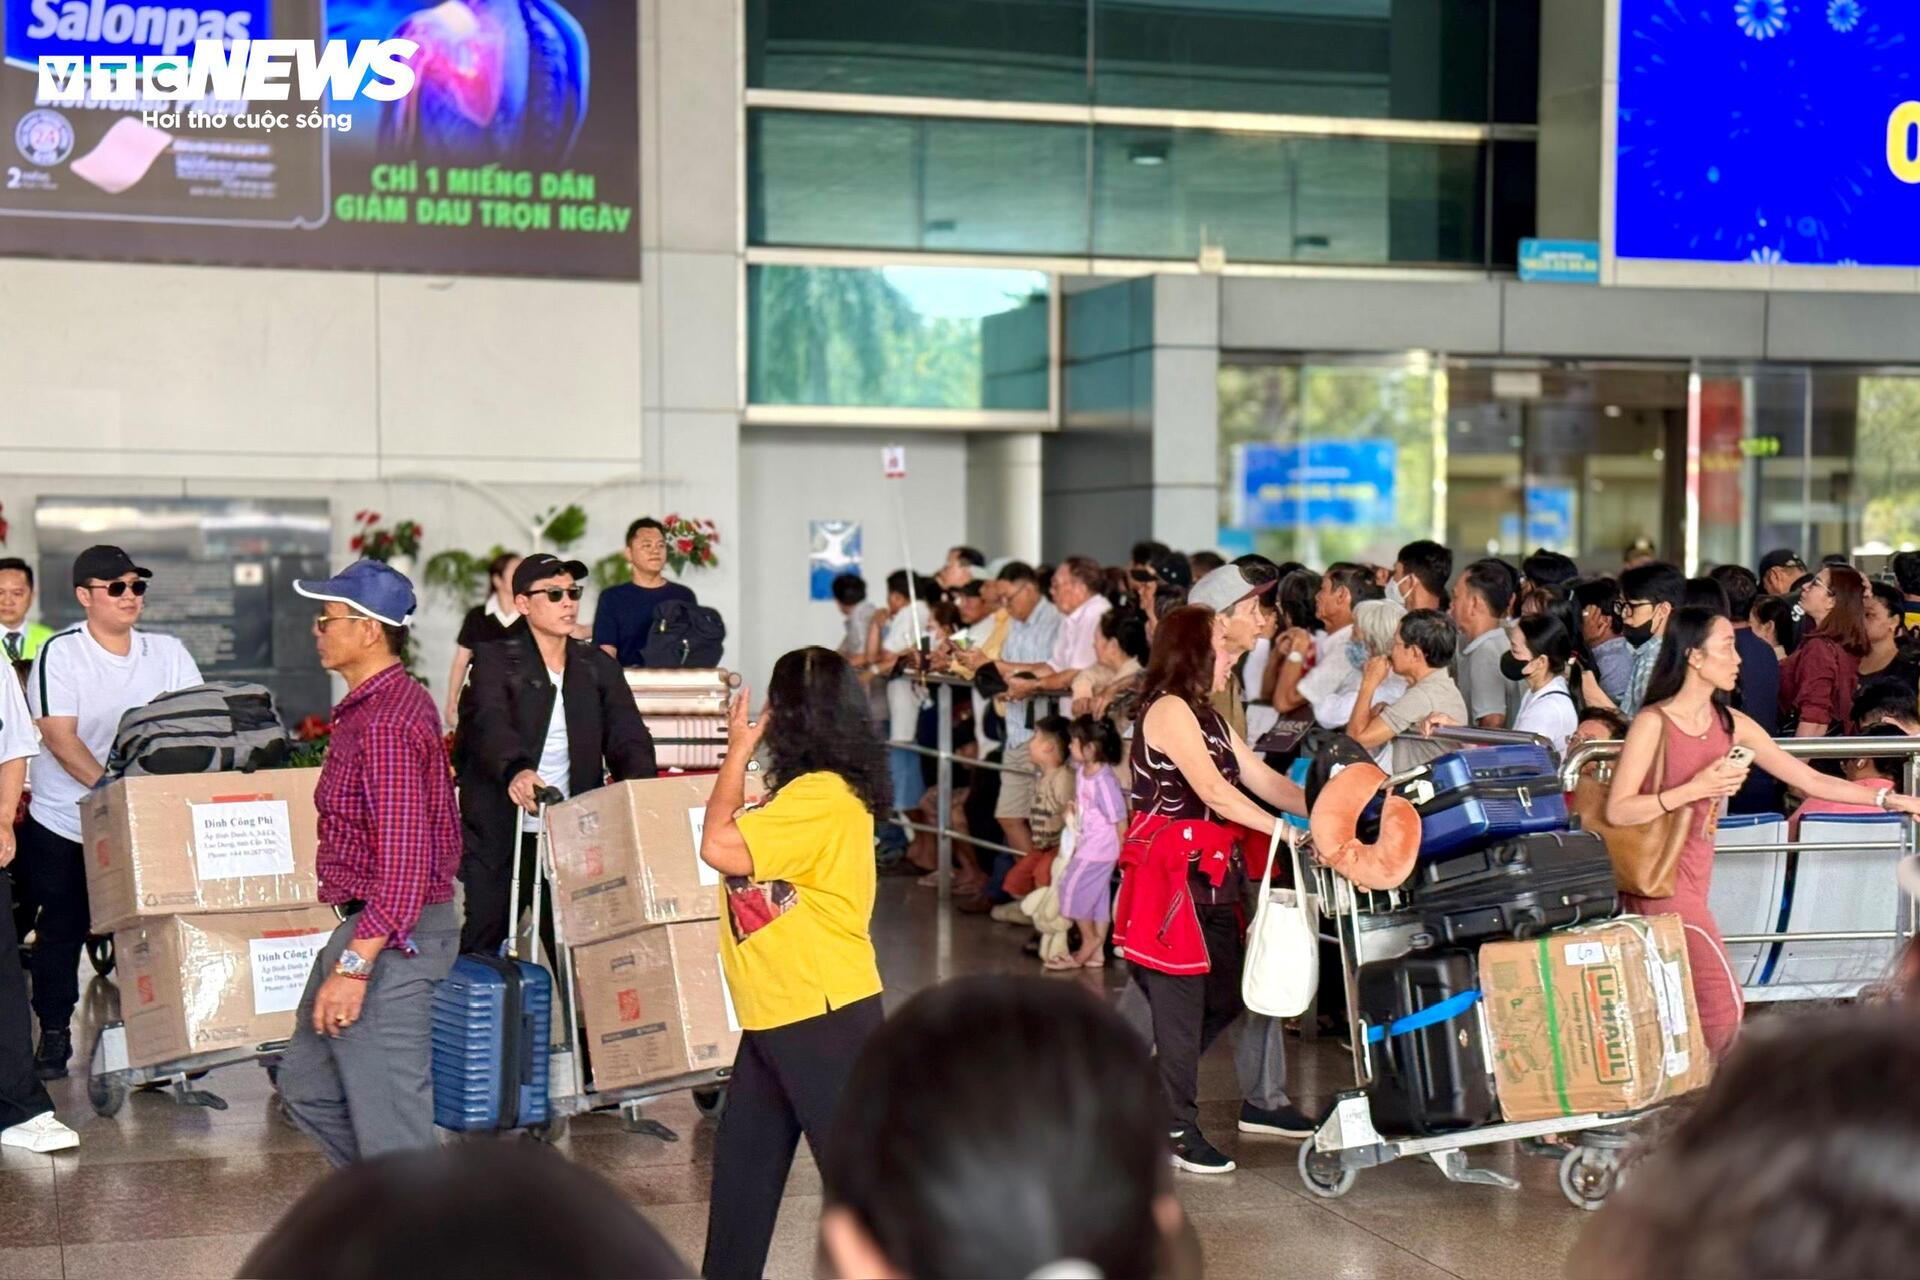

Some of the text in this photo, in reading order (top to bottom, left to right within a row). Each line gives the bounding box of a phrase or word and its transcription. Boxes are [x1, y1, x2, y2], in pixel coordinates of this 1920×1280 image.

[27, 0, 251, 55] Salonpas
[7, 166, 21, 189] 2
[425, 166, 440, 194] 1
